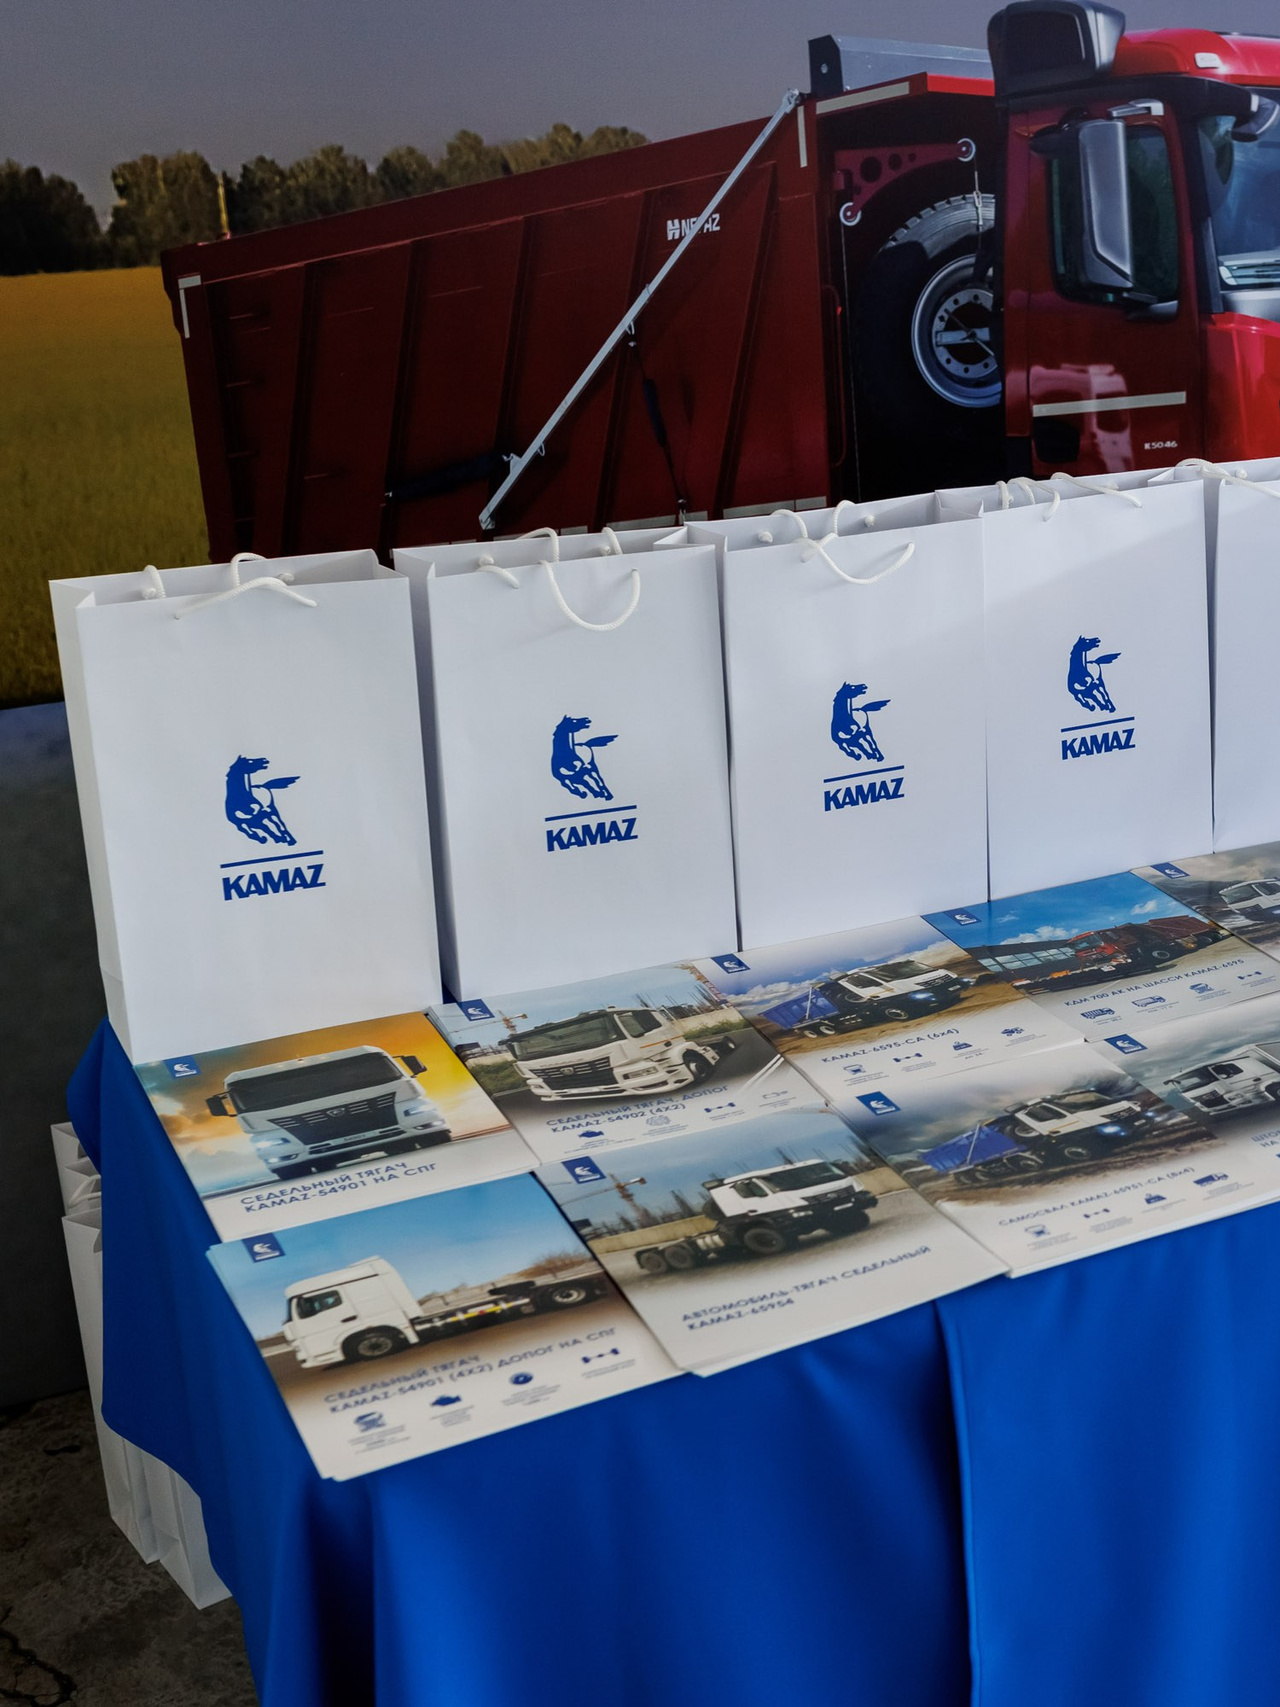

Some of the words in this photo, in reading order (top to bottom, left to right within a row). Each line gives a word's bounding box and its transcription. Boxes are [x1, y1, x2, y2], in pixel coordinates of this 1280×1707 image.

[681, 213, 721, 237] NEAZ
[1060, 728, 1136, 761] KAMAZ
[823, 777, 905, 812] KAMAZ
[546, 817, 638, 852] KAMAZ
[222, 863, 326, 901] KAMAZ
[1144, 973, 1184, 989] ШАССИ
[546, 1104, 633, 1127] СЕДЕЛЬНЫЙ
[682, 1085, 729, 1101] ДОПОГ
[551, 1110, 647, 1134] KAMAZ-54902
[1260, 1136, 1280, 1149] НА
[240, 1173, 352, 1206] СЕДЕЛЬНЫЙ
[355, 1162, 408, 1179] ТЯГАЧ
[244, 1180, 368, 1213] KAMAZ-54901
[373, 1171, 400, 1185] НА
[404, 1162, 438, 1177] СПГ
[840, 1244, 932, 1280] СЕДЕЛЬНЫЙ
[497, 1343, 554, 1369] ДОПОГ
[557, 1335, 582, 1351] НА
[586, 1326, 617, 1342] СПГ
[324, 1367, 430, 1403] СЕДЕЛЬНЫЙ
[433, 1354, 481, 1375] ТЯГАЧ
